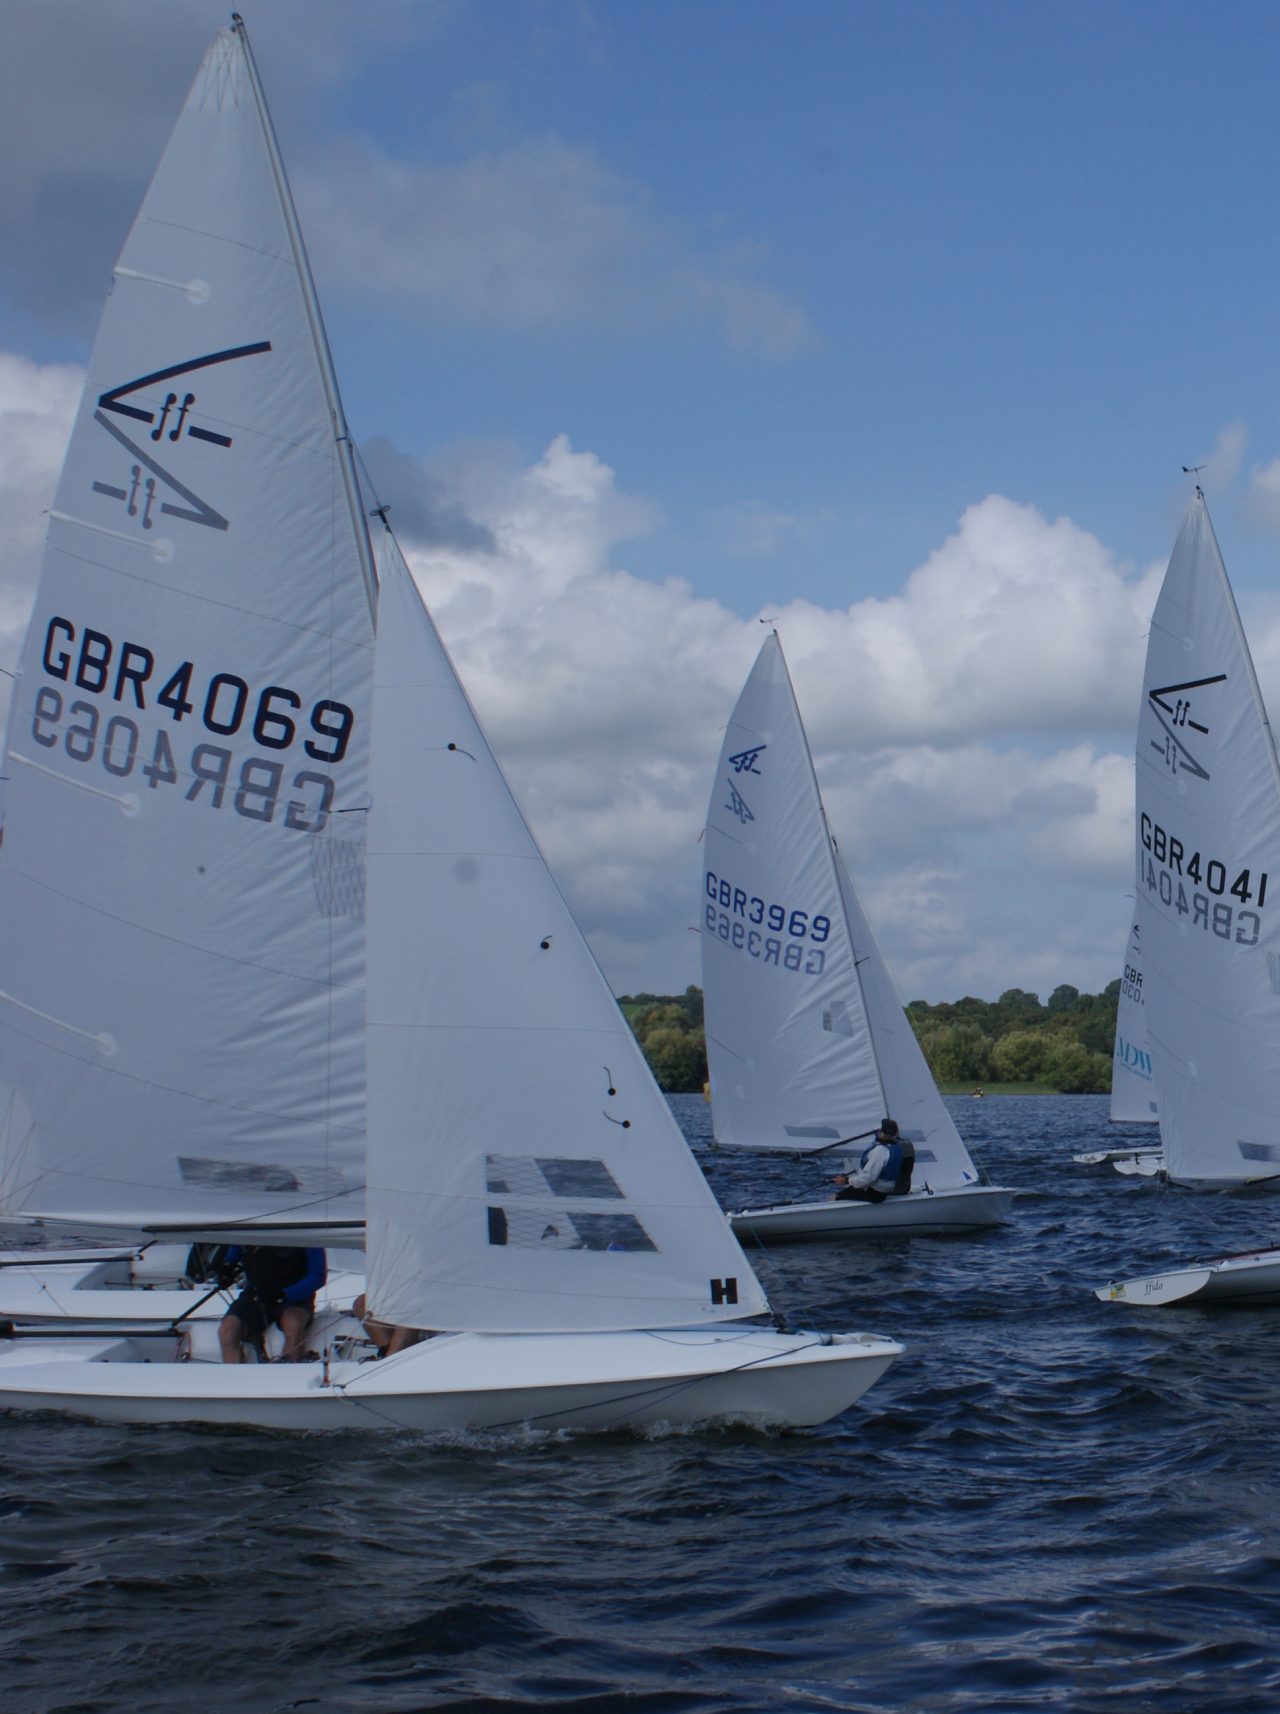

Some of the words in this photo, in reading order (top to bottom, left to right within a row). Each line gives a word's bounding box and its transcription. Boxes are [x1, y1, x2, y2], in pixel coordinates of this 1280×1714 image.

[42, 616, 354, 763] GBR4069
[706, 871, 831, 943] GBR3969
[1141, 811, 1268, 907] GBR4041
